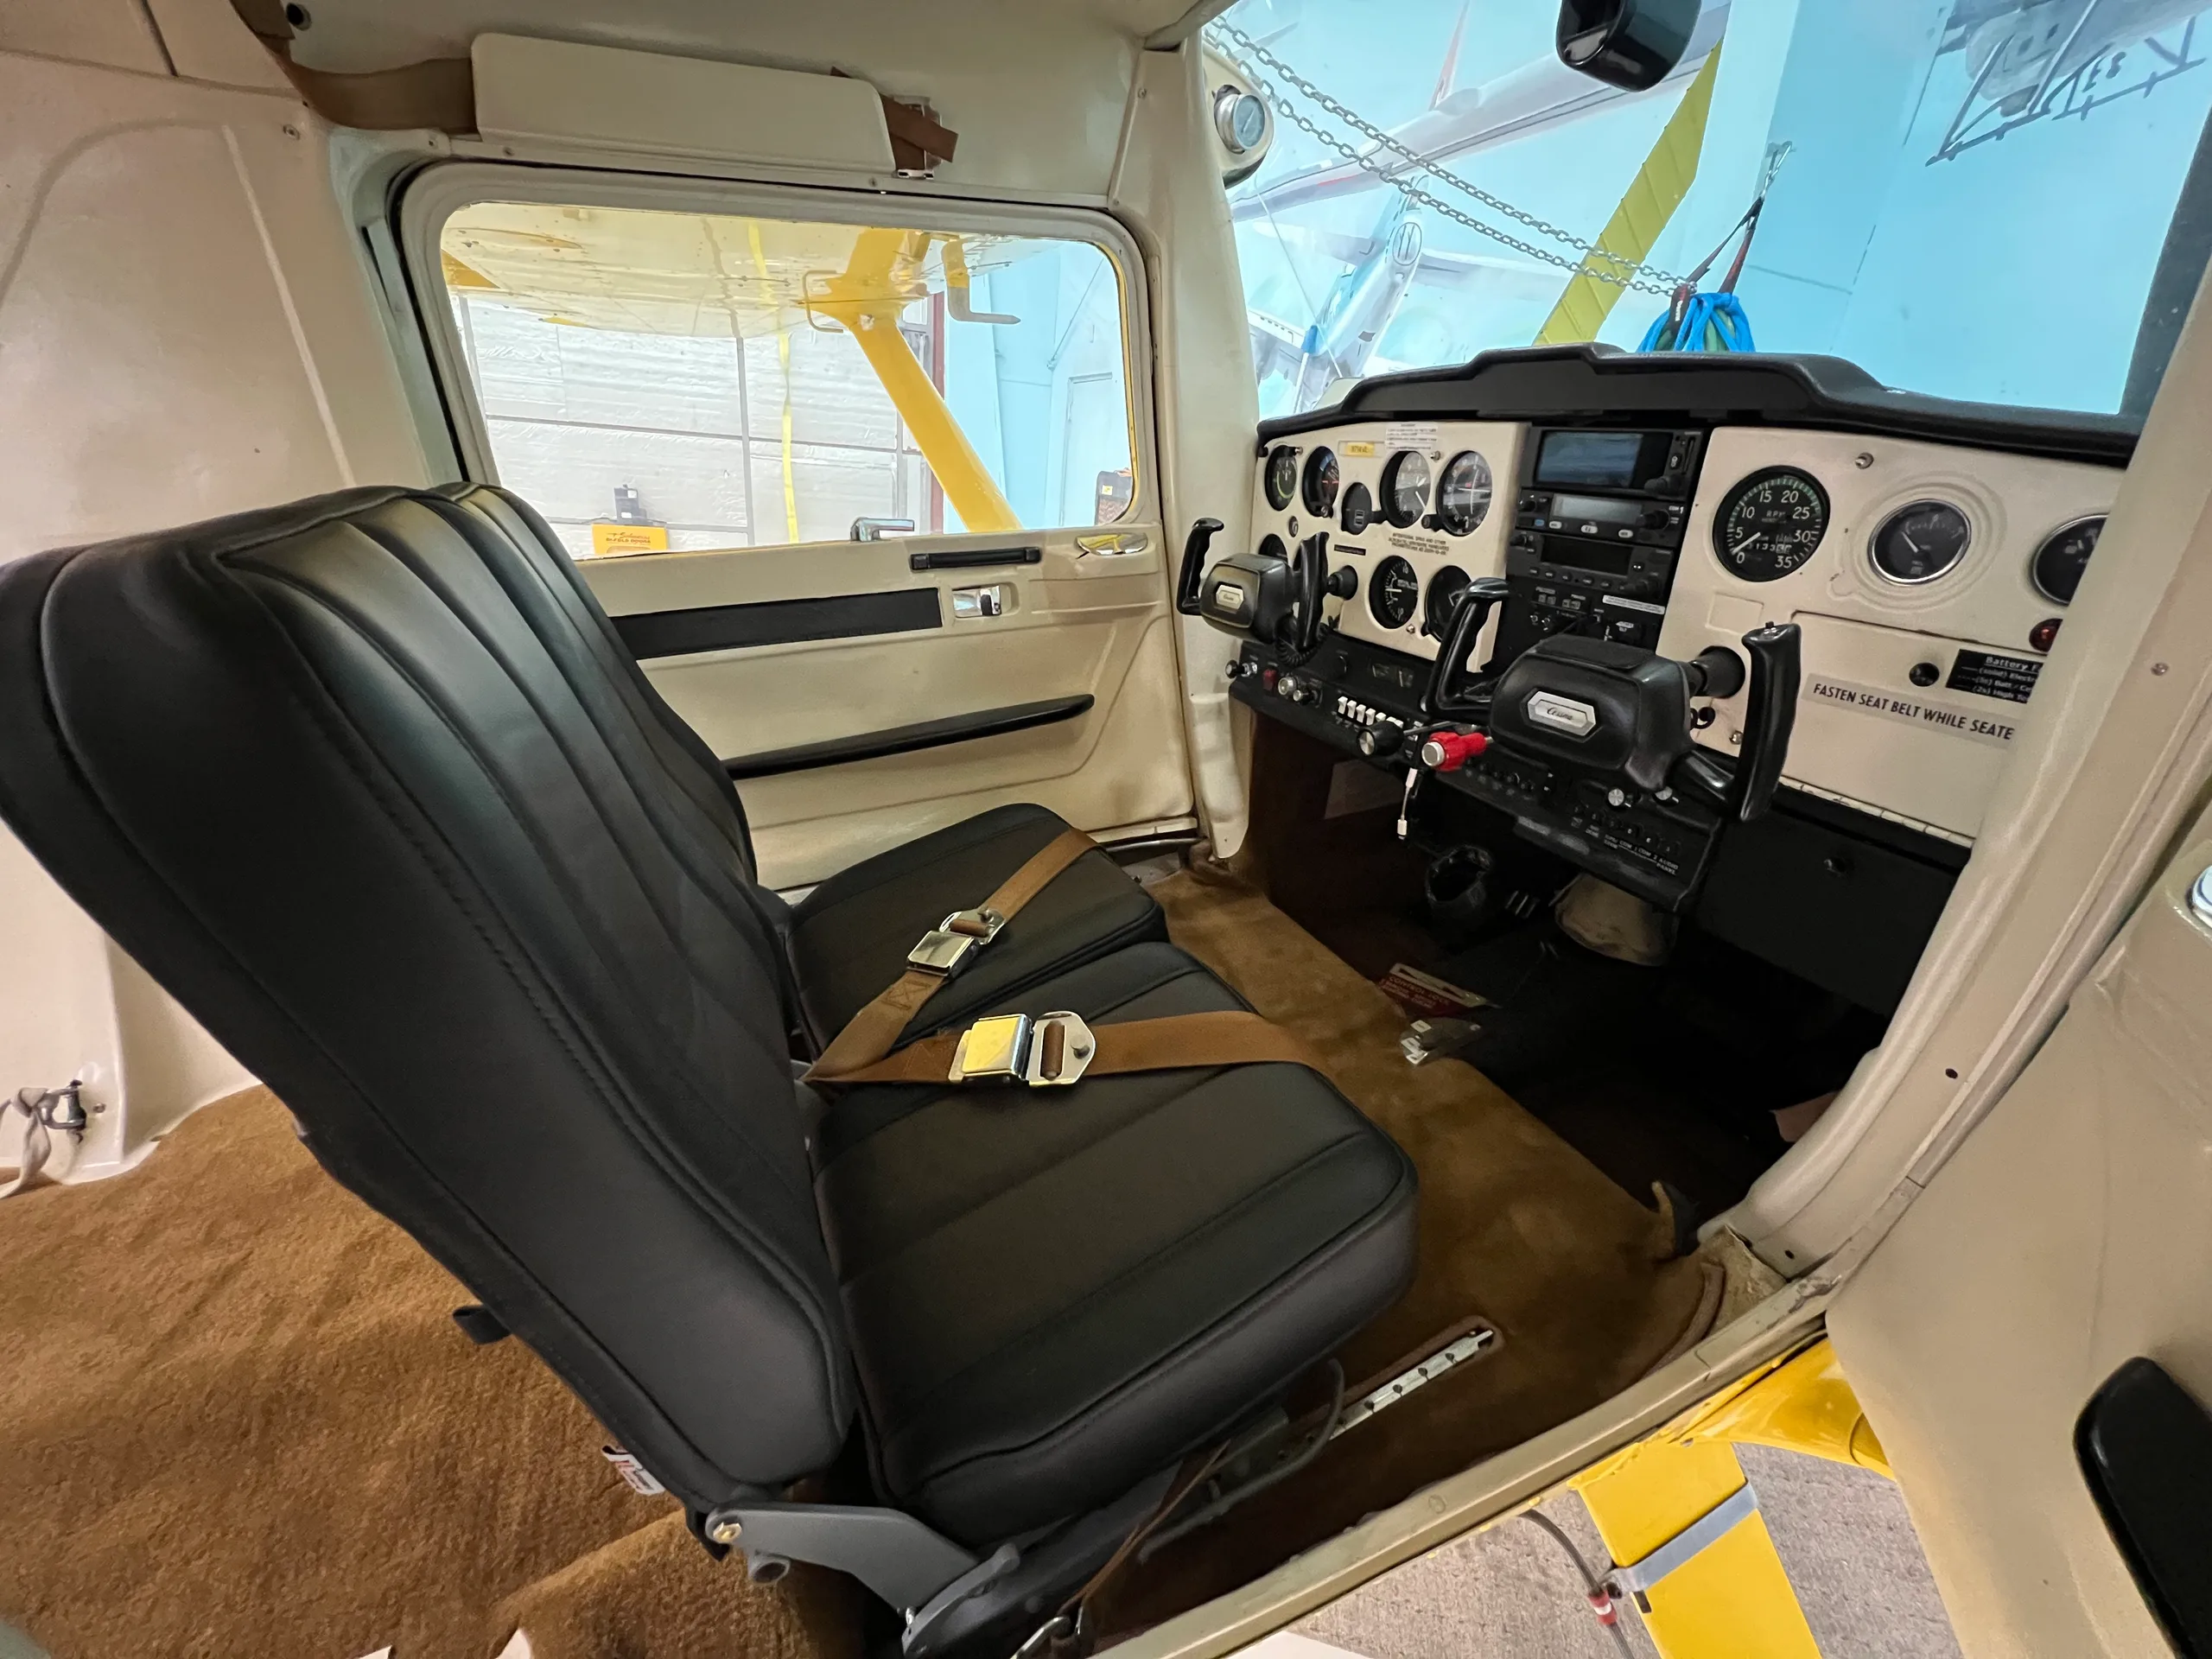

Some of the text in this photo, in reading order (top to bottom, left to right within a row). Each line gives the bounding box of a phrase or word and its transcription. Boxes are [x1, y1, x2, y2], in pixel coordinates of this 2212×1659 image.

[1759, 490, 1772, 503] 15
[1781, 490, 1799, 503] 20
[1741, 506, 1755, 518] 10
[1792, 506, 1810, 519] 25
[1735, 526, 1744, 538] 5
[1793, 530, 1811, 543] 30
[1737, 551, 1745, 563] 0
[1775, 555, 1793, 569] 35
[1986, 656, 2028, 671] Battery
[1813, 683, 2015, 740] FASTEN SEAT BELT WHILE SEATE
